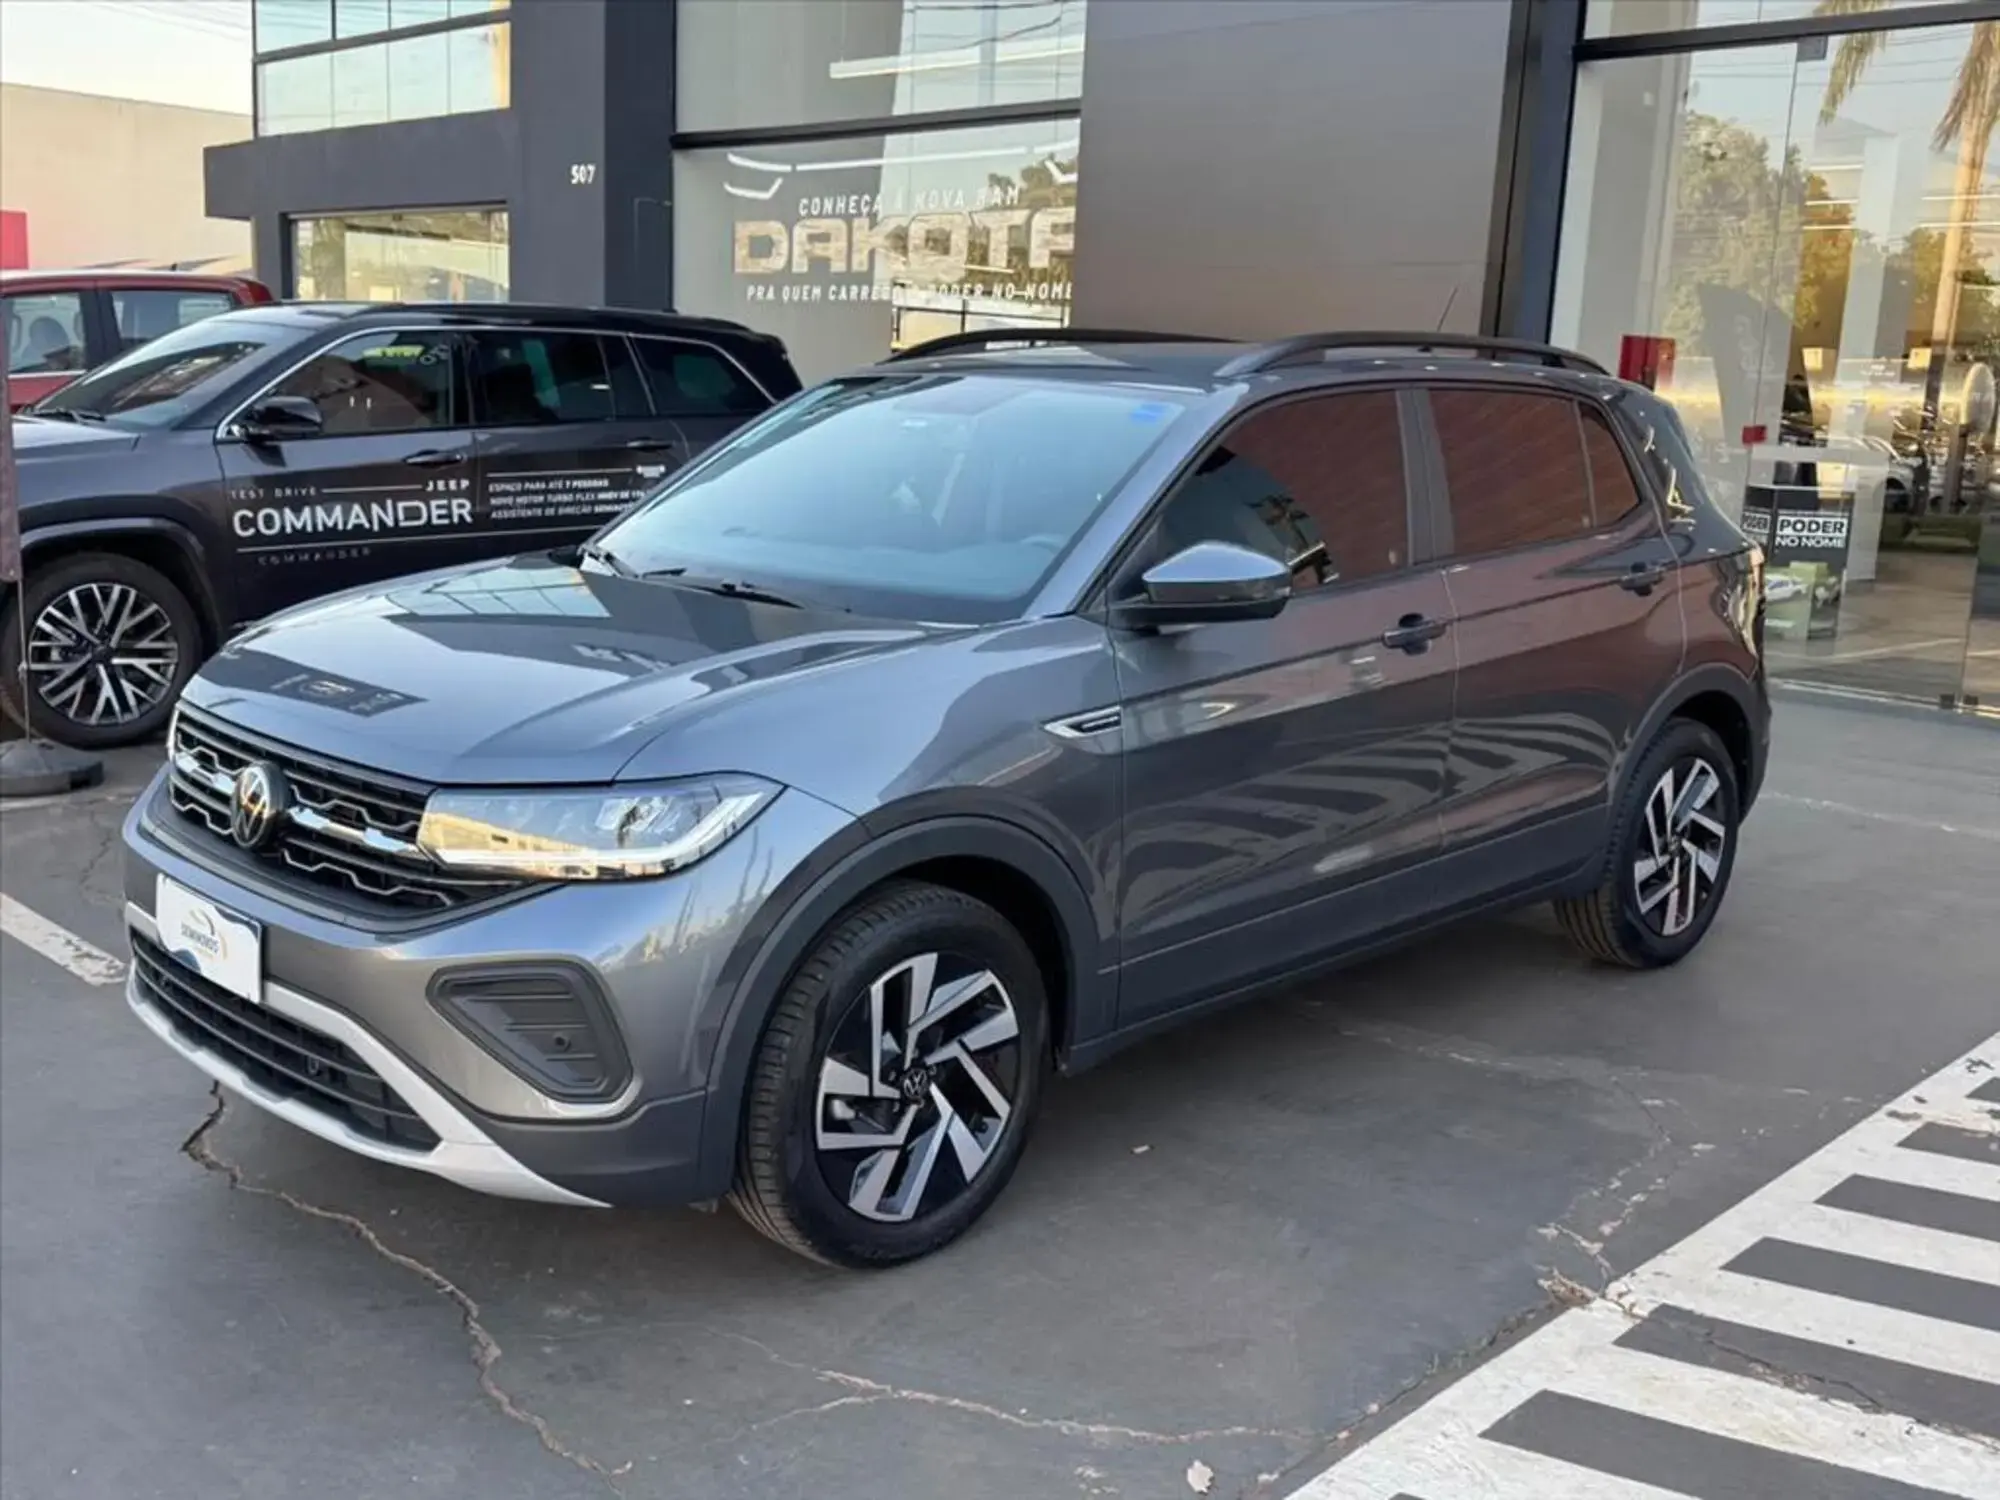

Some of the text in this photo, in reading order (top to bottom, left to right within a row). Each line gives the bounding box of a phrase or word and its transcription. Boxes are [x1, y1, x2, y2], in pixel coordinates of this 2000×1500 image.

[571, 163, 596, 184] 507
[798, 192, 882, 217] CONHEÇA
[747, 285, 775, 300] PRA
[782, 285, 822, 302] QUEM
[828, 284, 903, 301] CARREG
[231, 479, 470, 499] TEST DRIVE JEEP
[232, 498, 473, 537] COMMANDER
[1779, 519, 1845, 534] PODER
[1776, 537, 1799, 547] NO
[1801, 537, 1845, 548] NOME
[257, 547, 371, 566] COMMANDER
